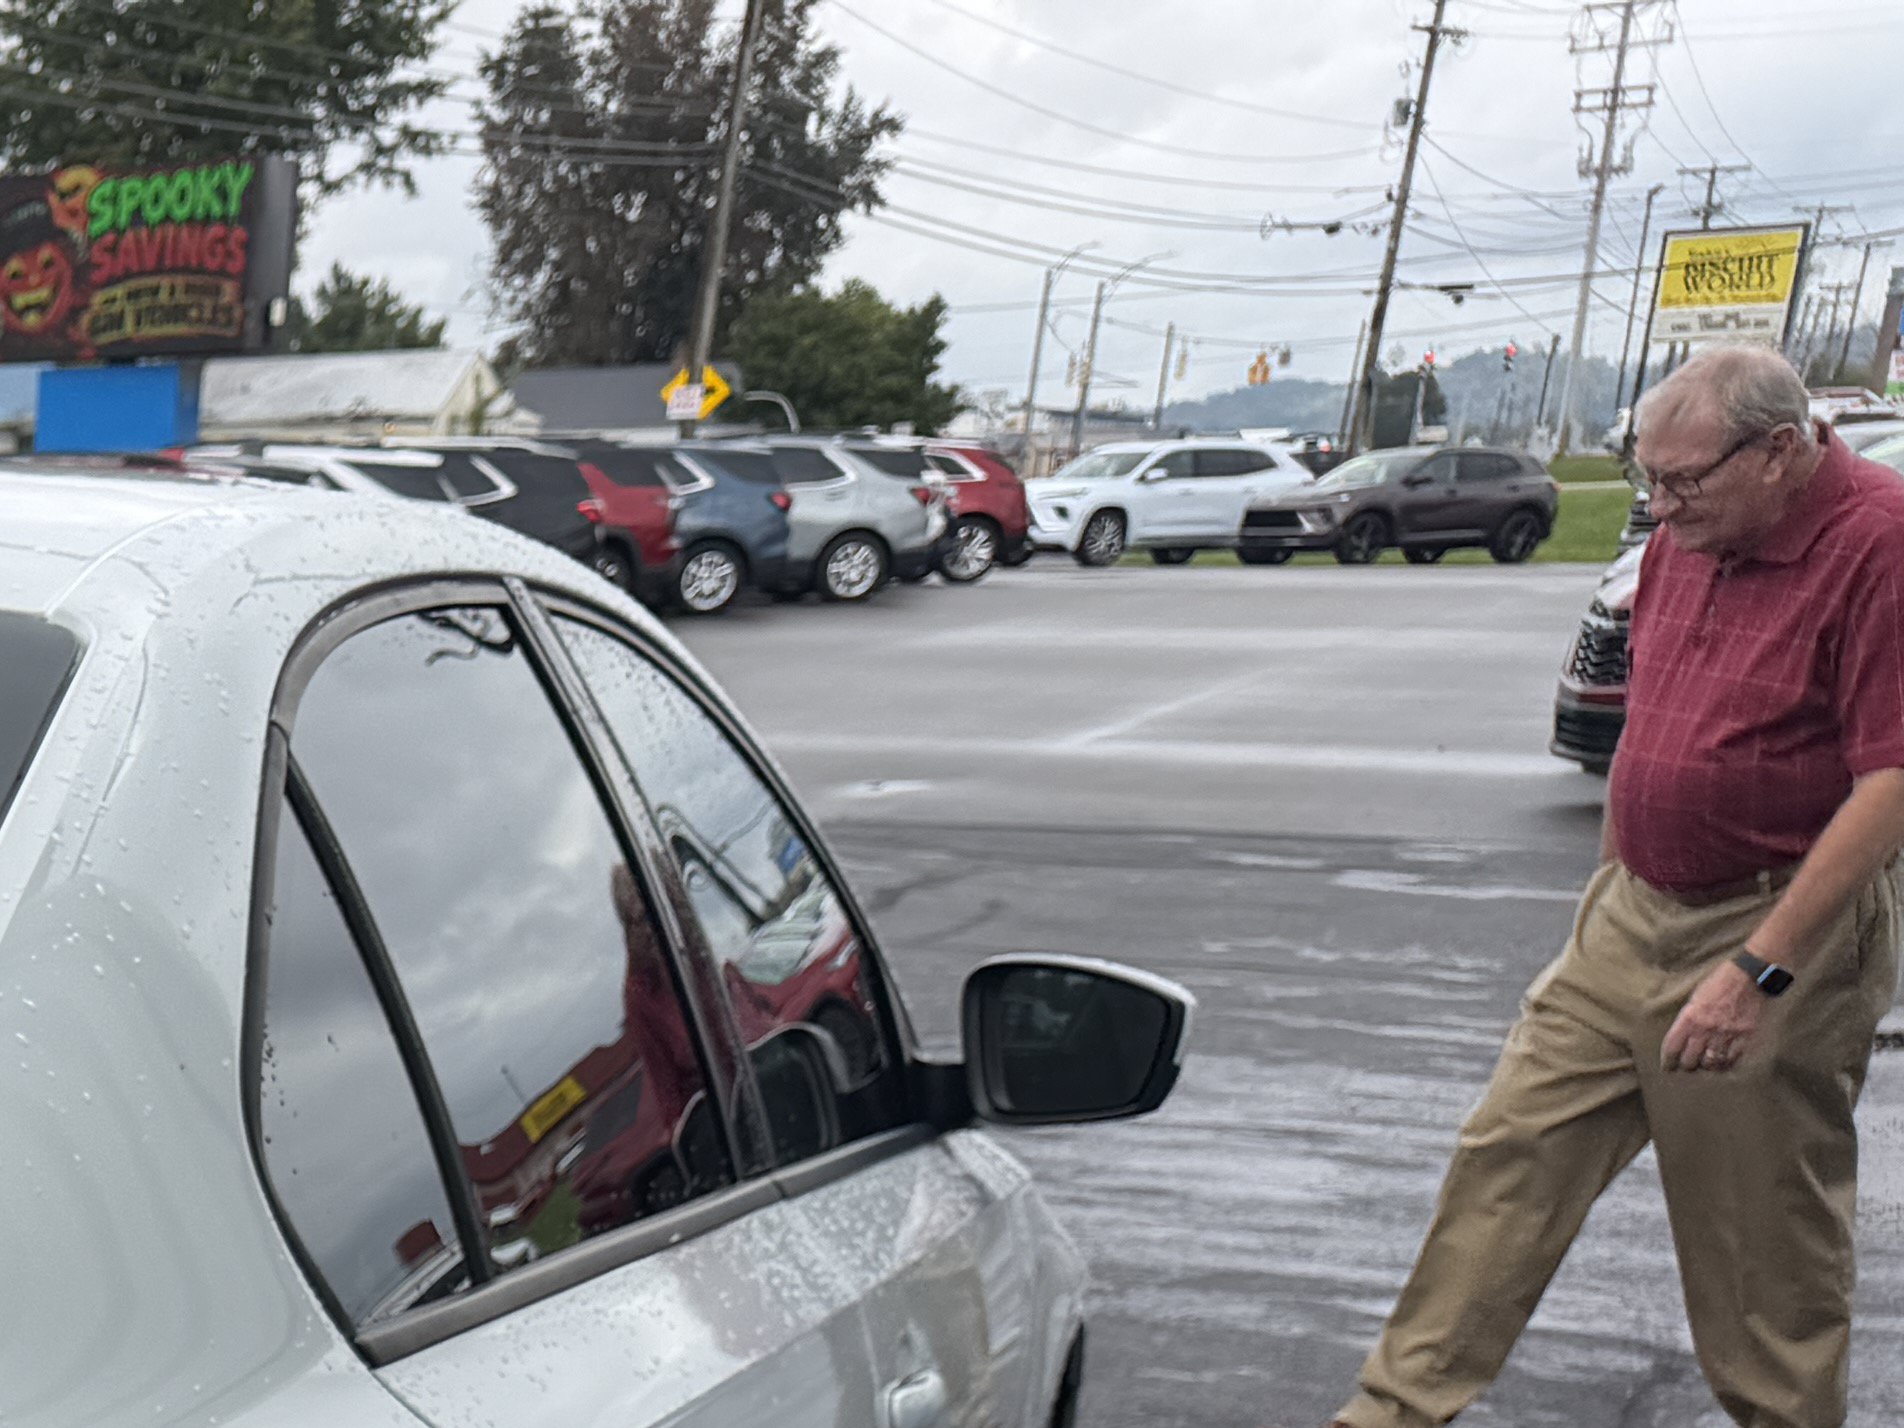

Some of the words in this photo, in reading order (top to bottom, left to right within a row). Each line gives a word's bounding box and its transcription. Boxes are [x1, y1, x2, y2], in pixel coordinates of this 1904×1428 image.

[87, 162, 253, 237] SPOOKY
[93, 224, 248, 280] SAVINGS
[1684, 270, 1775, 294] WORLD
